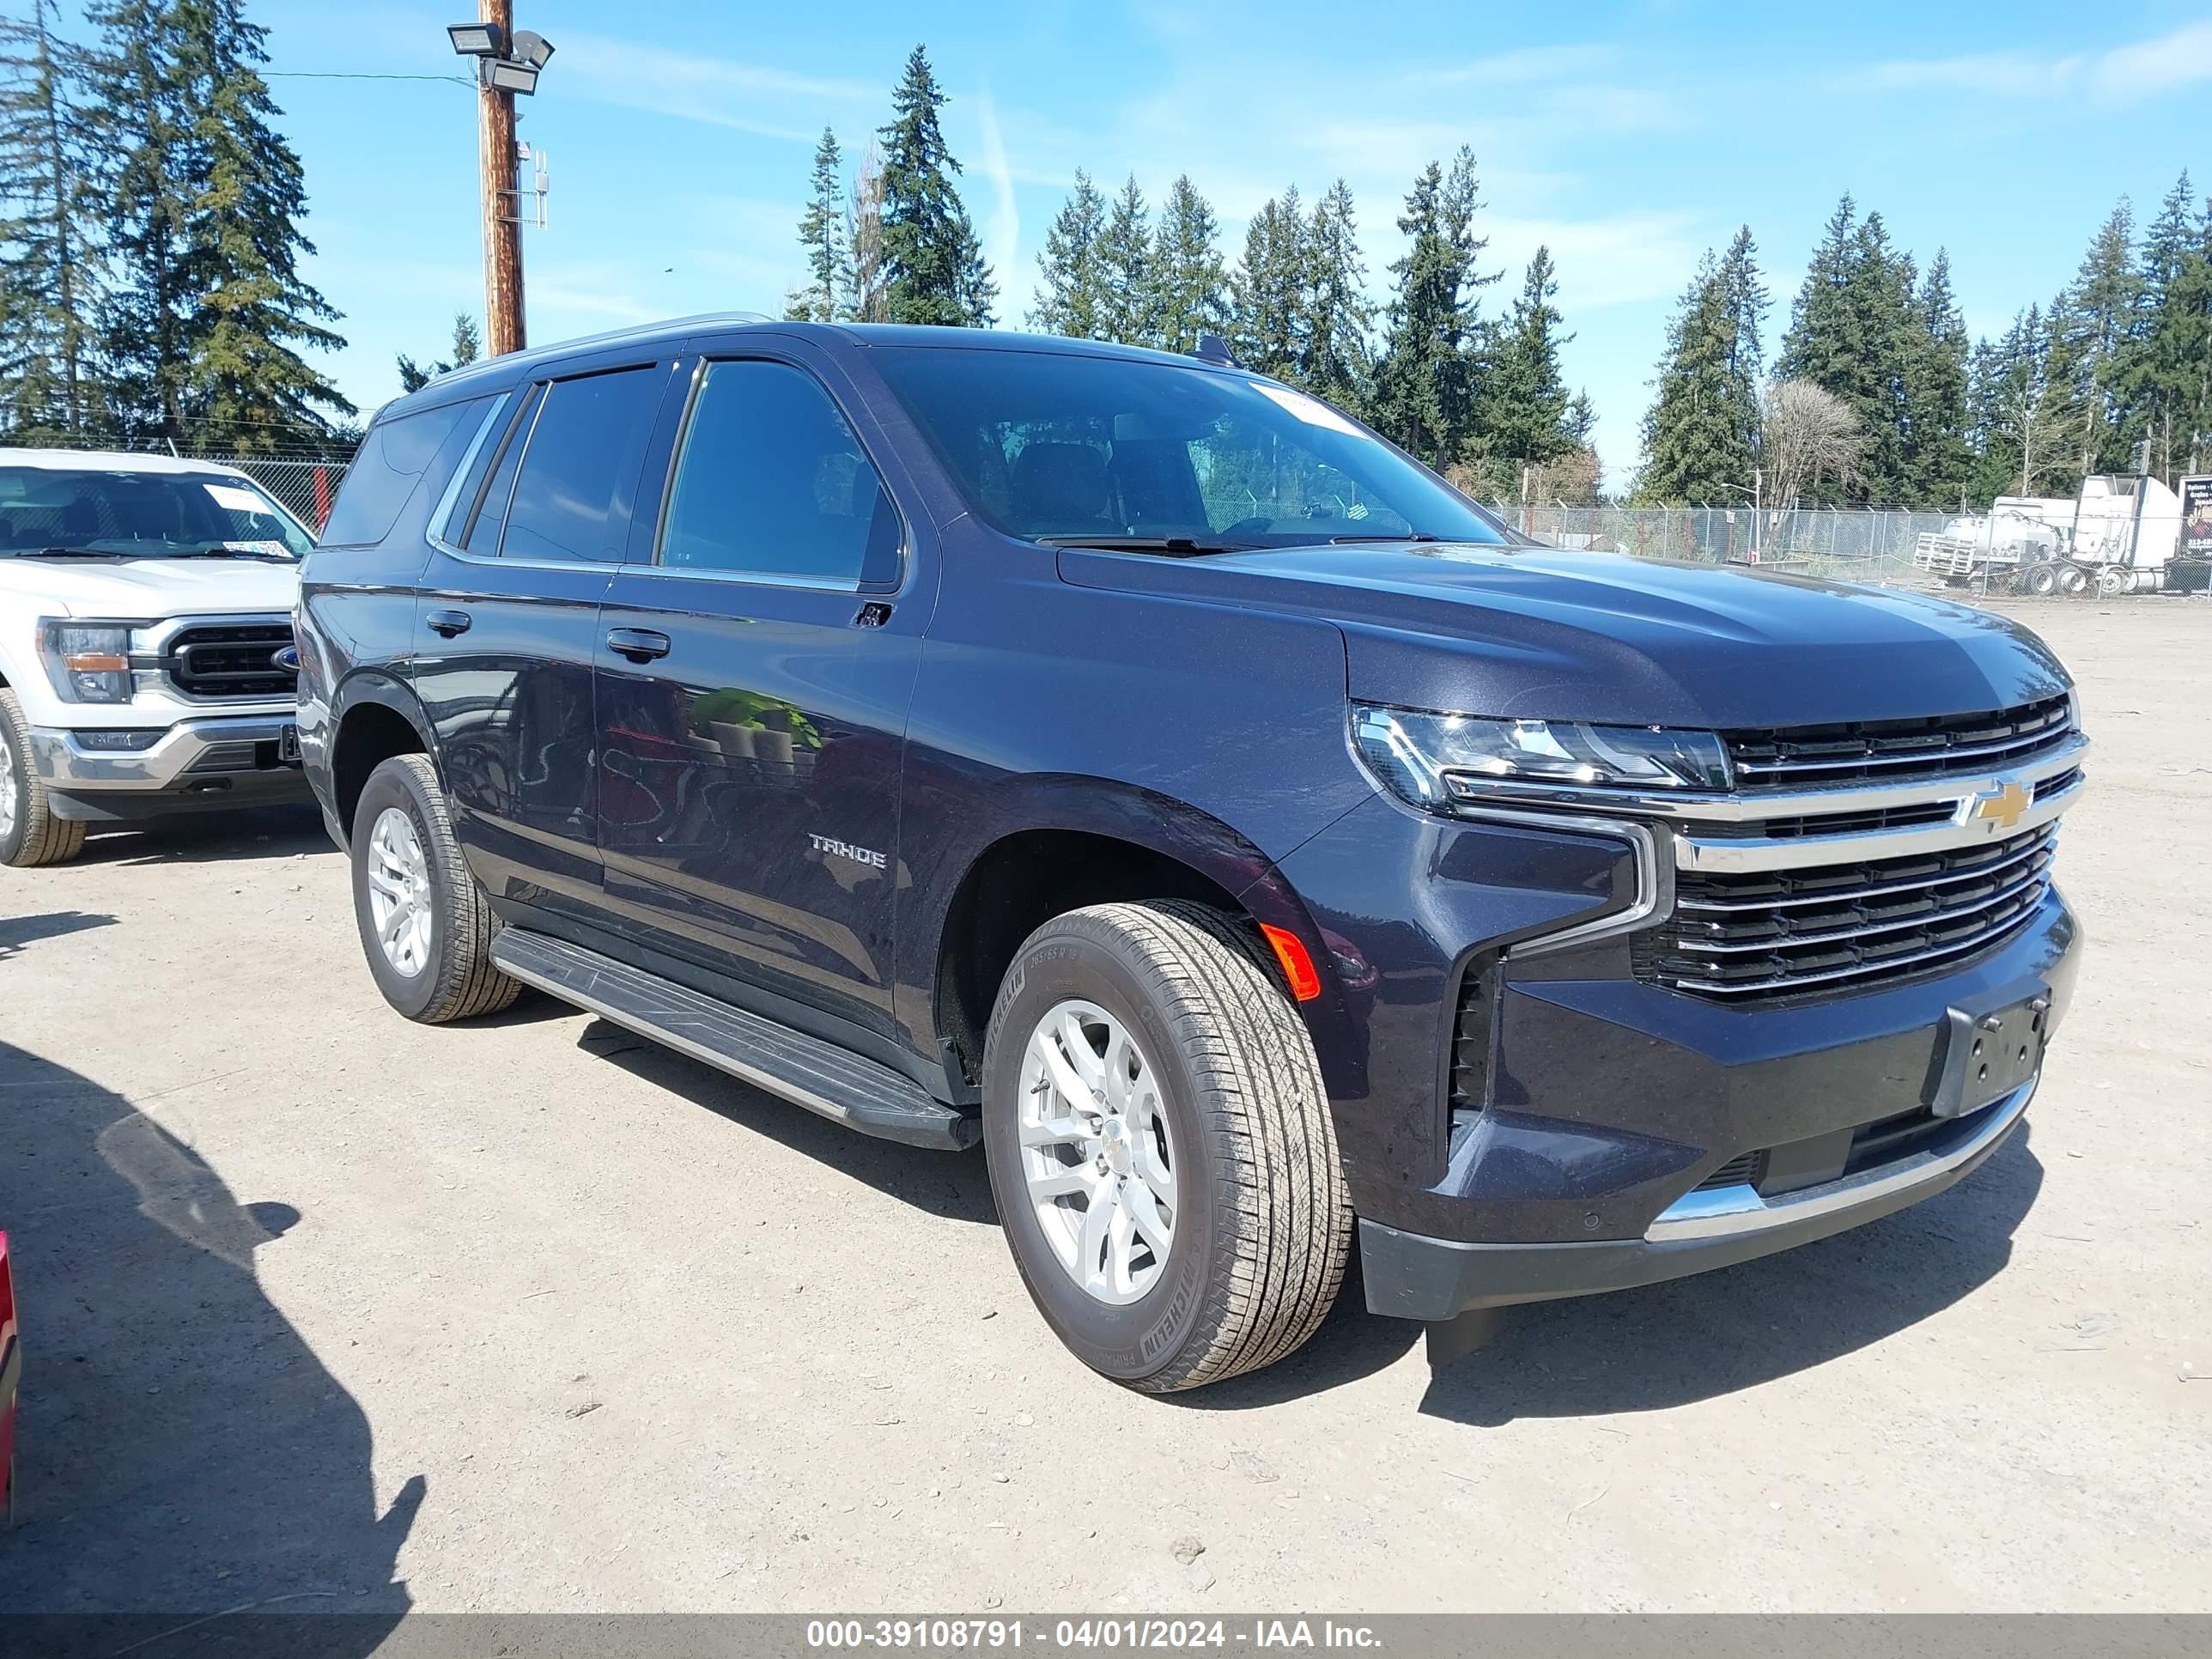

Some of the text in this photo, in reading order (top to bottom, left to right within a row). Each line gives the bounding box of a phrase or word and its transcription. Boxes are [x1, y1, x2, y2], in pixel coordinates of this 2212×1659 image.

[809, 833, 887, 869] TAHOE
[987, 968, 1023, 1066] MICHELIN
[1144, 1259, 1197, 1358] MICHELIN
